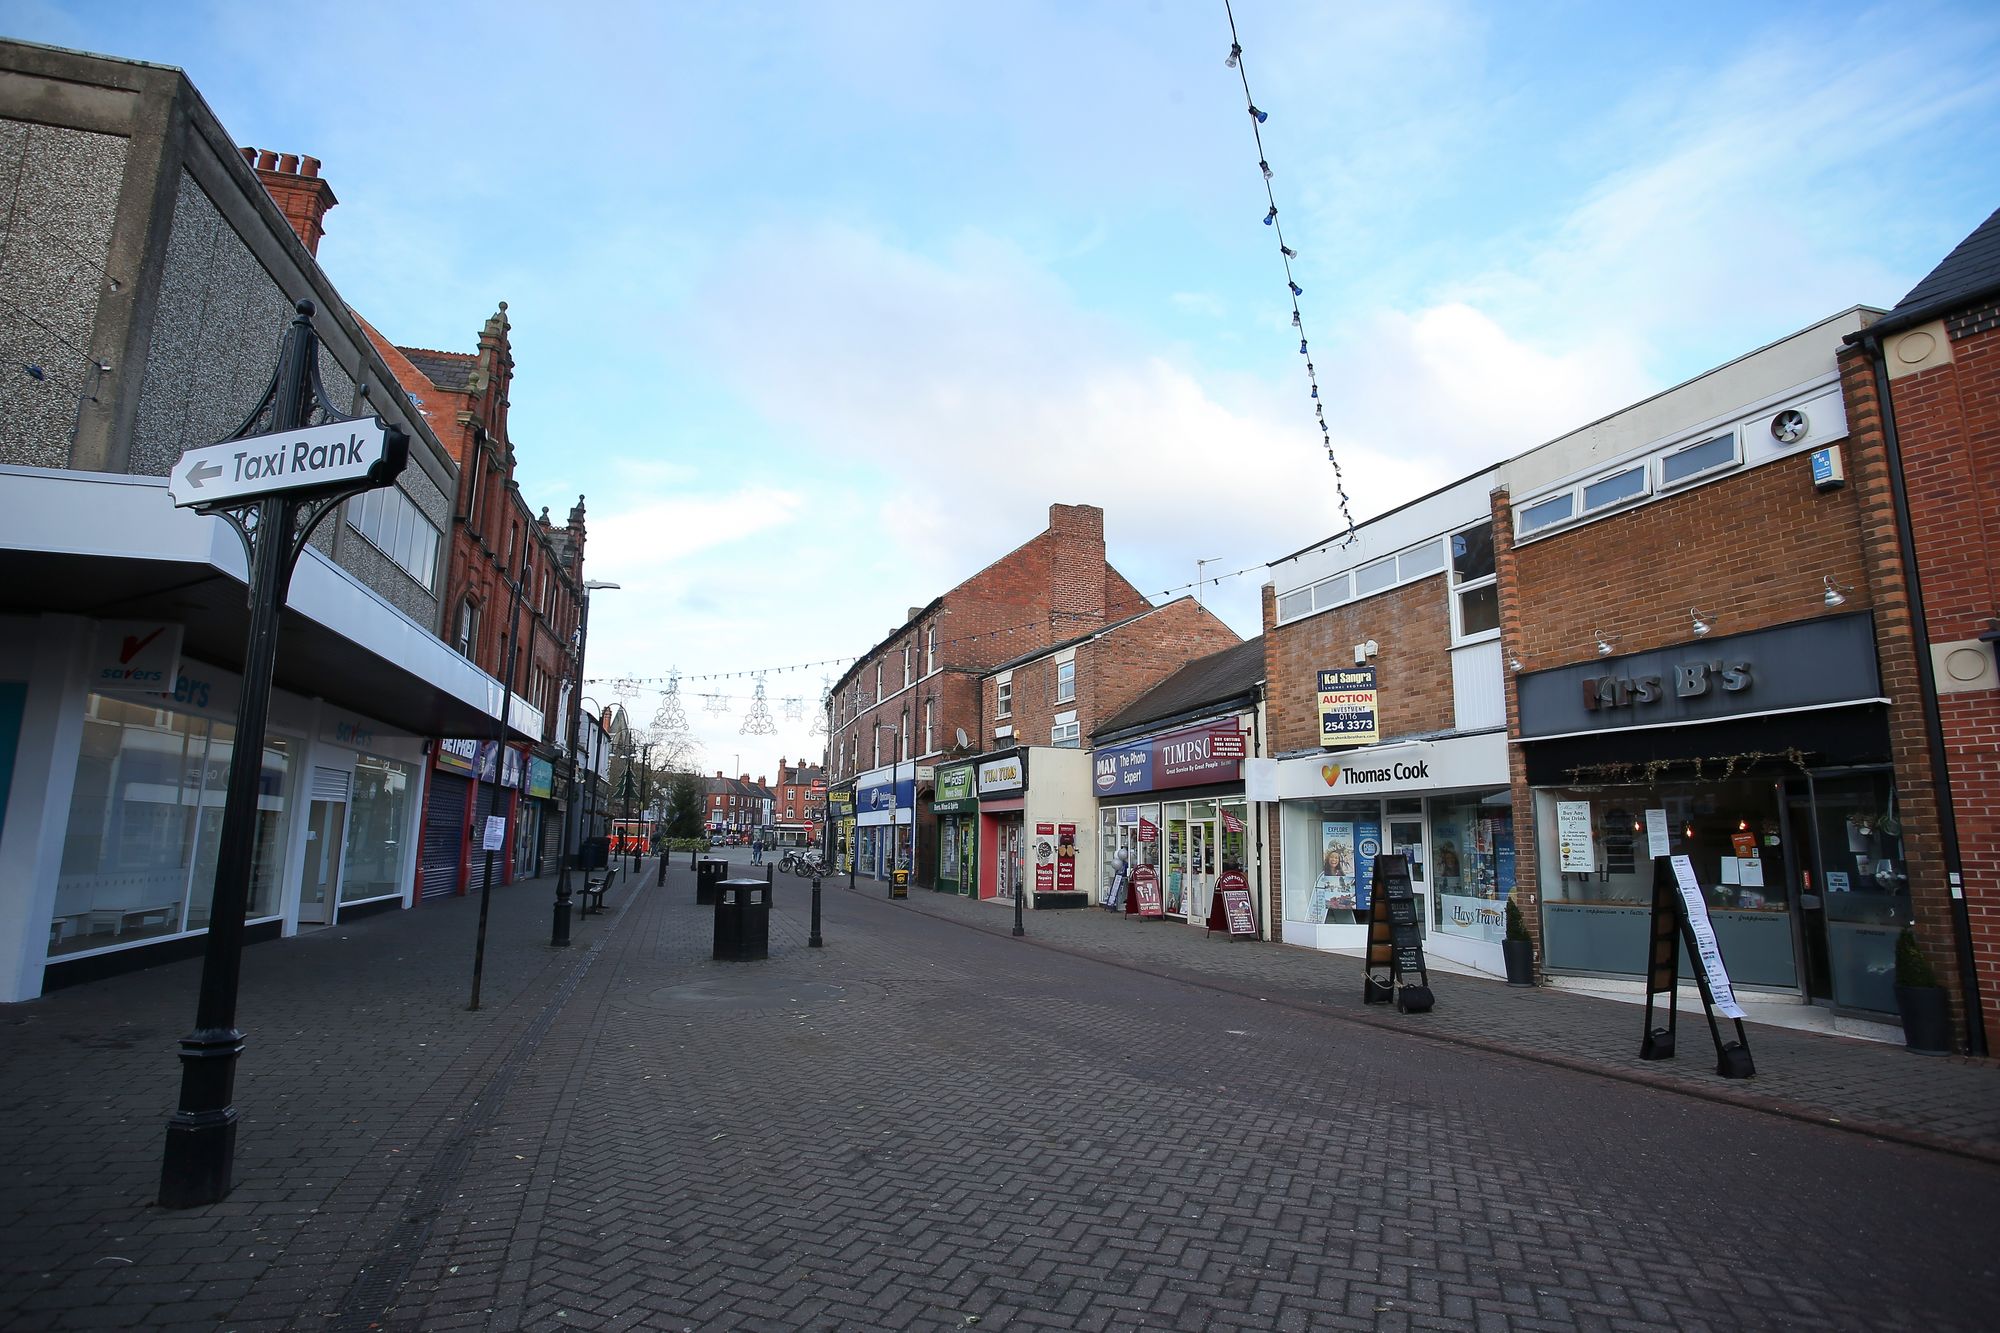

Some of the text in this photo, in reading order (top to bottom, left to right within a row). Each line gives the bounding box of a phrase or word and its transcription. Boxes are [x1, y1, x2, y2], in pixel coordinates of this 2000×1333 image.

[234, 433, 365, 482] Taxi Rank
[101, 667, 163, 680] savers
[1324, 672, 1372, 684] Kal Sangra
[1674, 659, 1753, 698] B's
[1322, 693, 1373, 704] AUCTION
[1331, 705, 1366, 713] INVESTMENT
[1339, 713, 1357, 721] 0116
[1325, 719, 1373, 731] 254 3373
[441, 738, 476, 759] BETFRED
[1163, 737, 1210, 766] TIMPSO
[1097, 757, 1117, 776] MAX
[1120, 751, 1146, 767] The Photo
[1124, 770, 1142, 786] Expert
[1343, 760, 1429, 784] Thomas Cook
[951, 775, 965, 786] POST
[1453, 905, 1504, 927] Hays Travel
